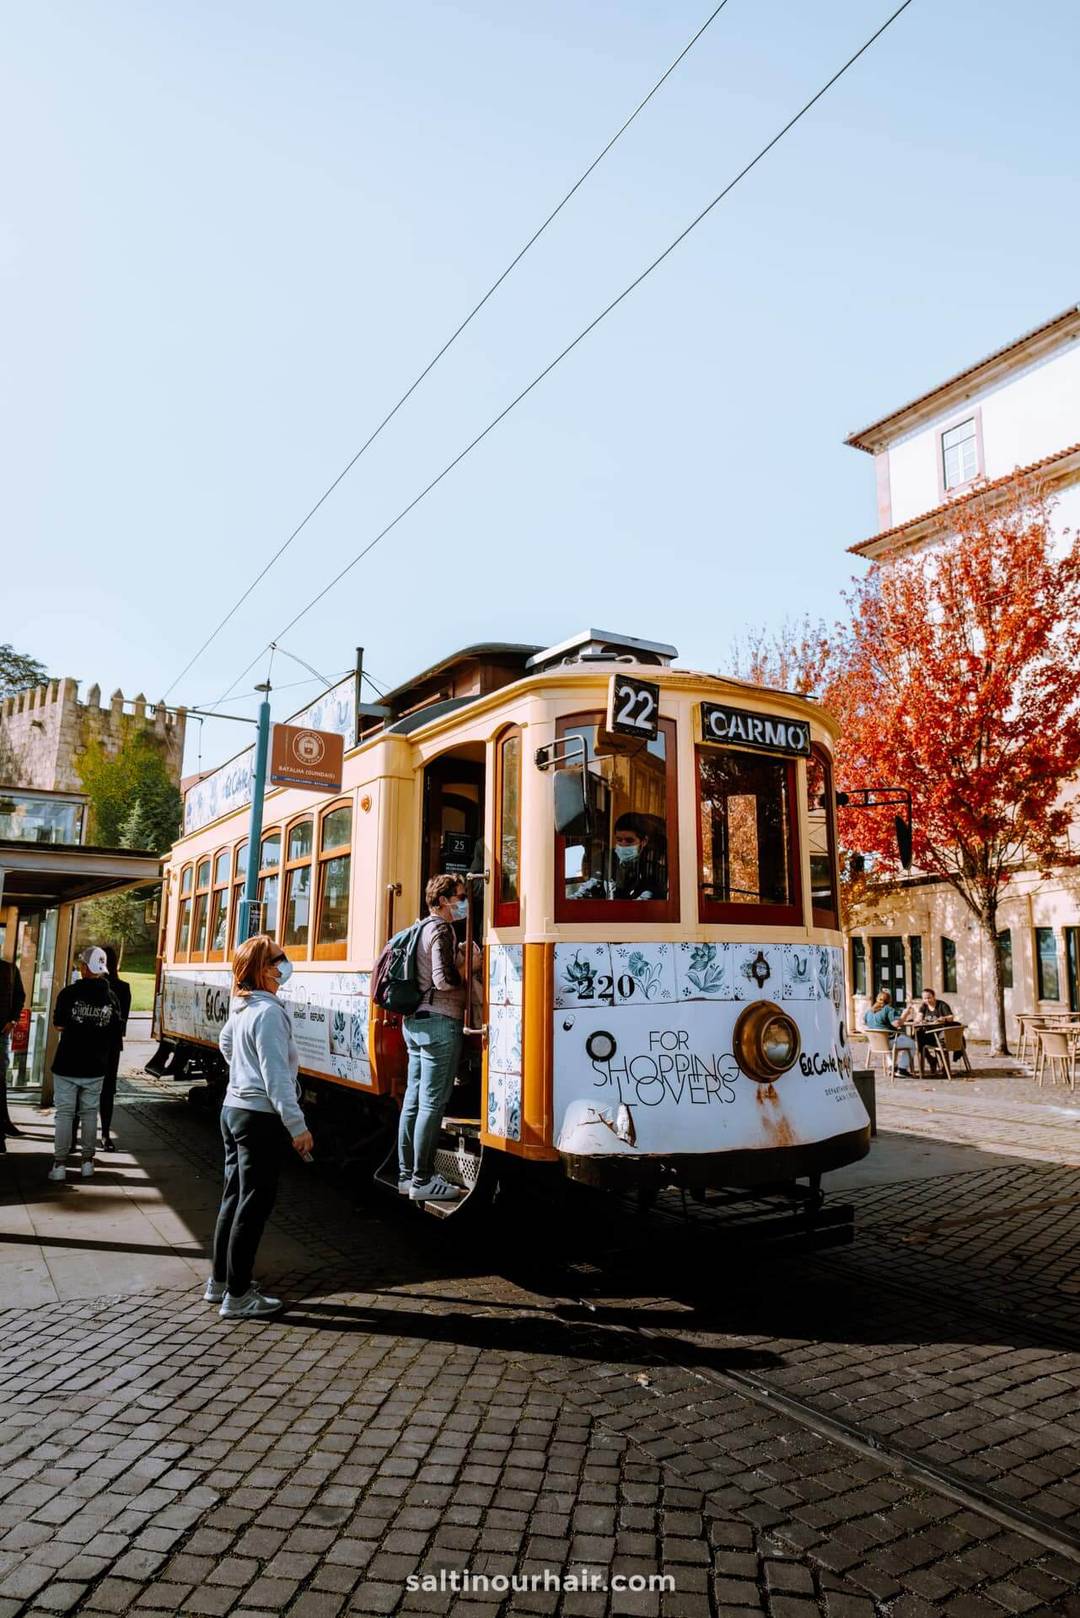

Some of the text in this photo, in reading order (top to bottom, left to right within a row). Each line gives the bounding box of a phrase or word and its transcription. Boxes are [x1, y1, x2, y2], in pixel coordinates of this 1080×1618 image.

[616, 685, 654, 731] 22
[709, 710, 805, 750] CARMO
[278, 765, 304, 774] BATALHA
[454, 840, 465, 850] 25
[577, 974, 635, 1000] 220
[649, 1030, 690, 1051] FOR
[591, 1053, 741, 1086] SHOPPING
[616, 1073, 736, 1107] LOVERS
